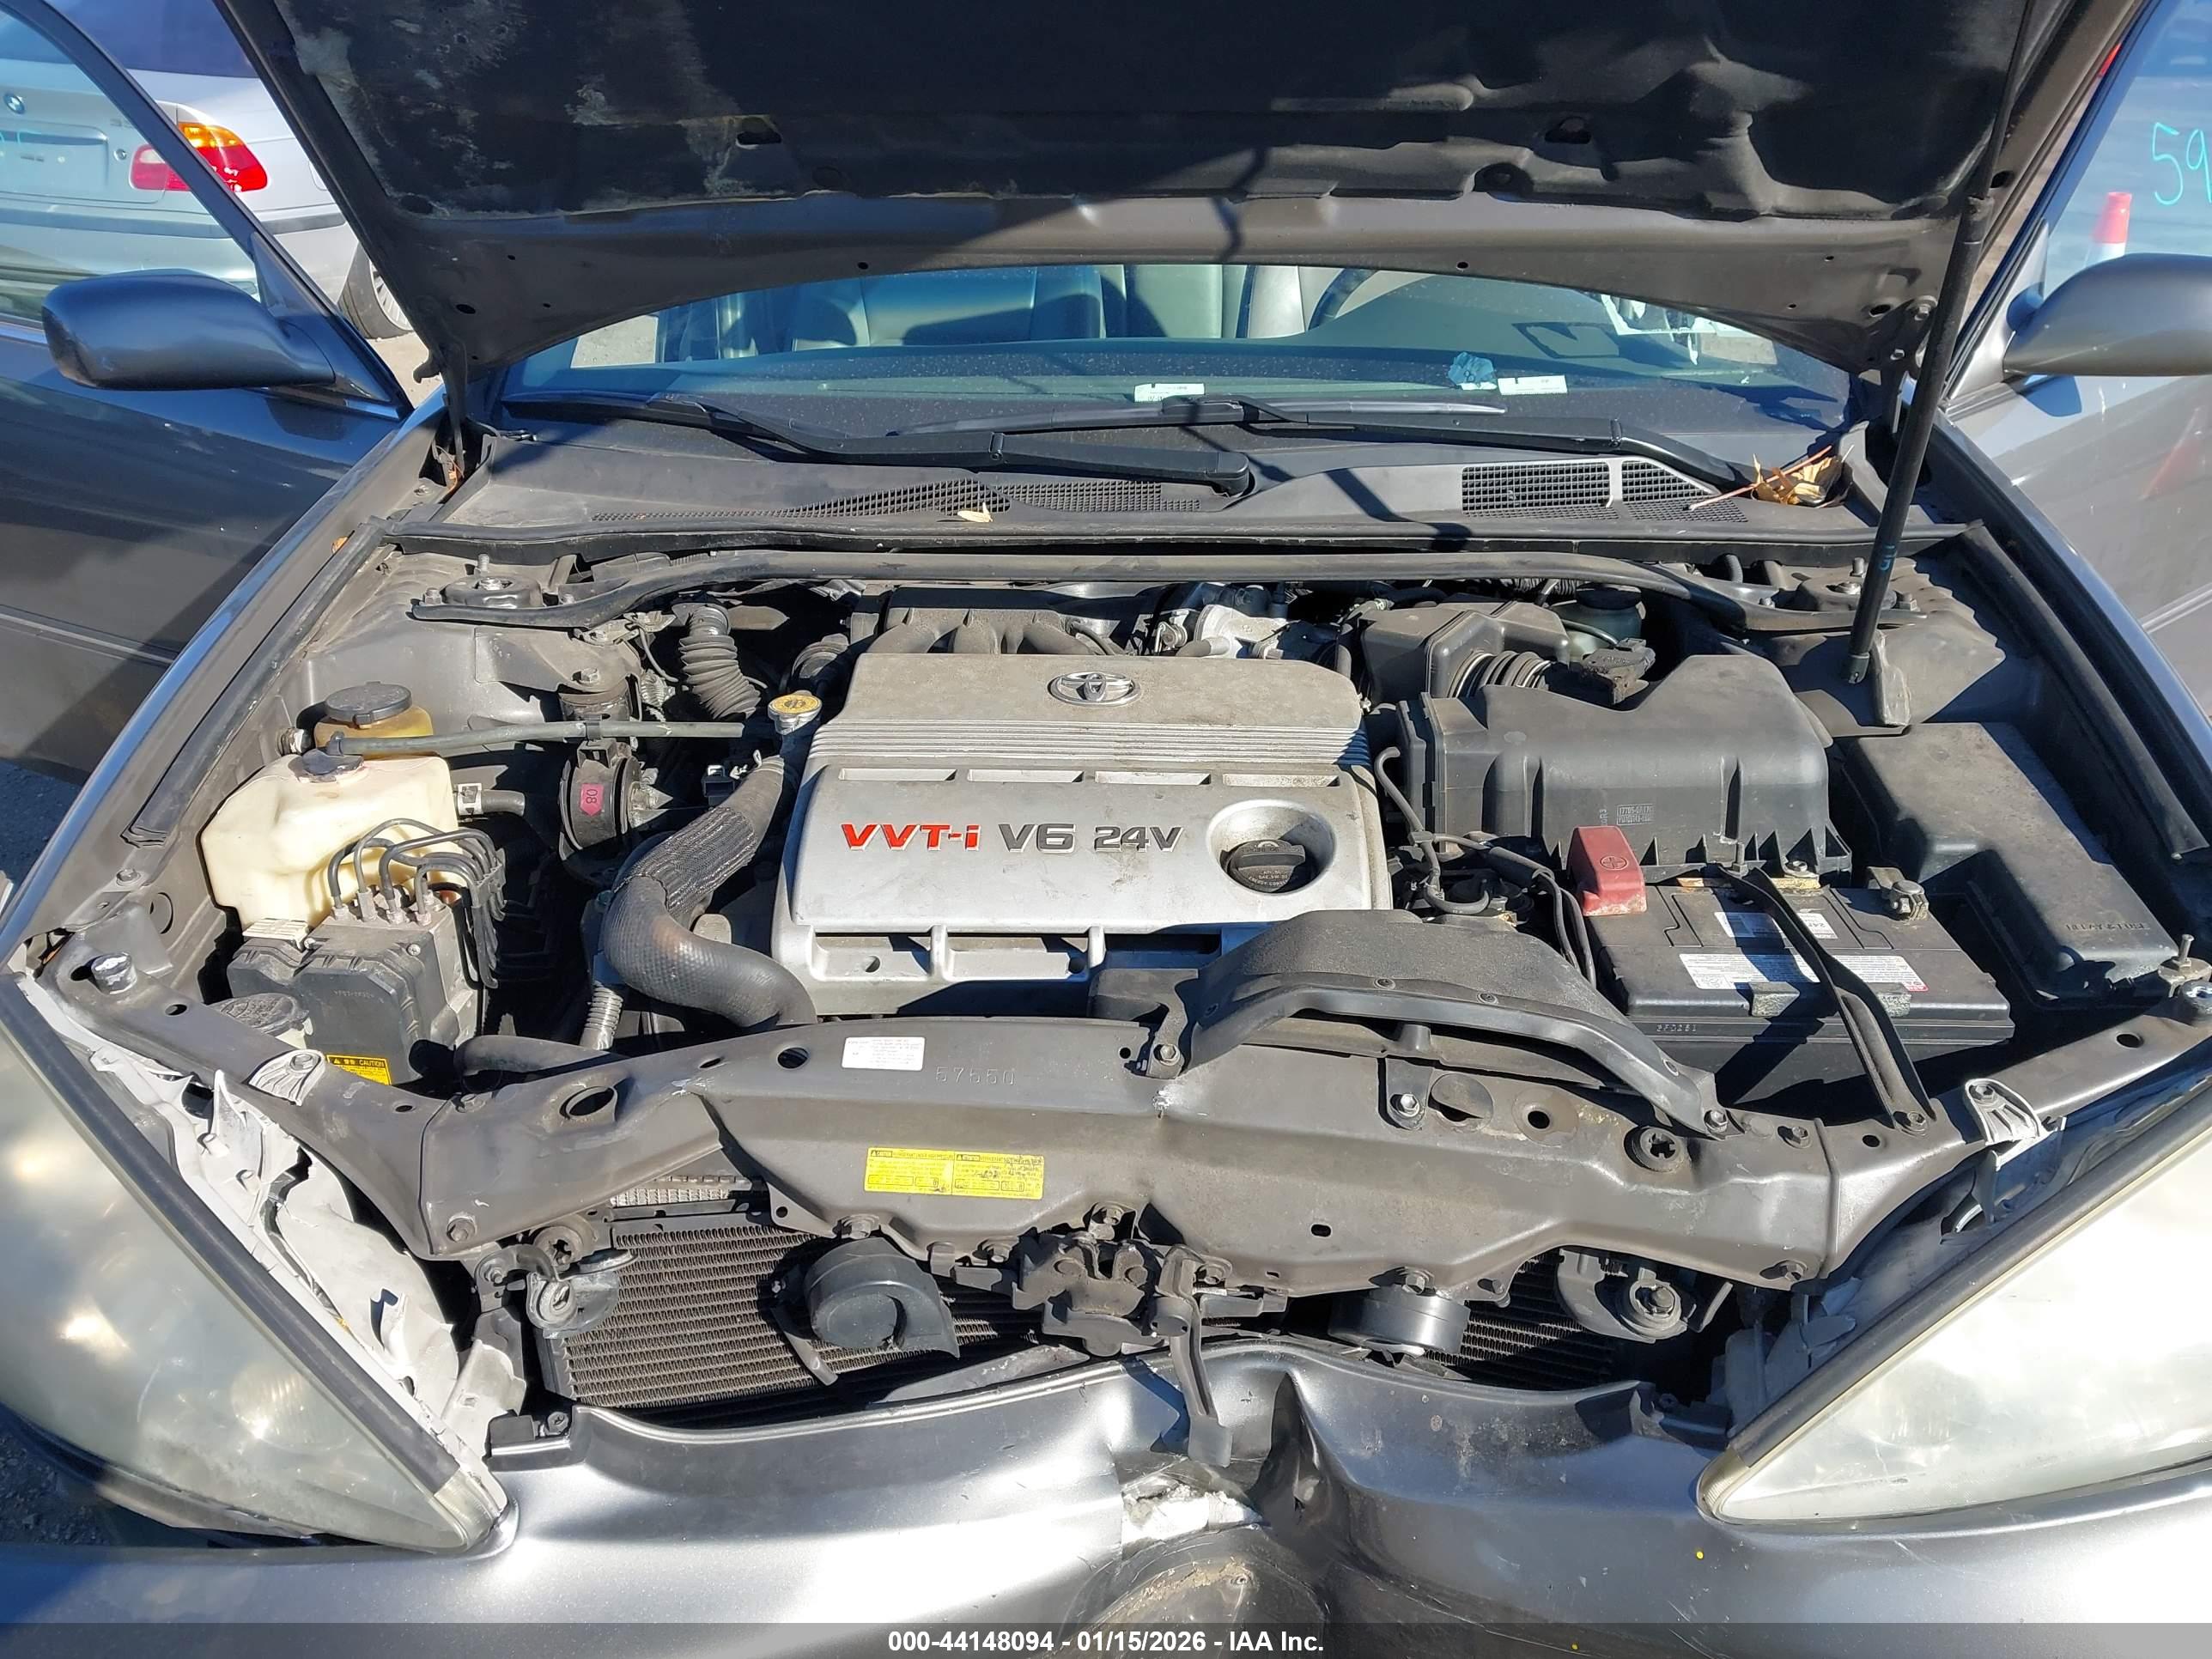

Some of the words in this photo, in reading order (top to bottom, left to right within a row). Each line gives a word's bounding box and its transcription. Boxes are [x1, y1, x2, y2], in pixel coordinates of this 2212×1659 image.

[2152, 122, 2212, 204] 59
[841, 823, 981, 852] VVT-i
[998, 823, 1077, 853] V6
[1093, 826, 1185, 853] 24V
[359, 1059, 385, 1067] CAUTION
